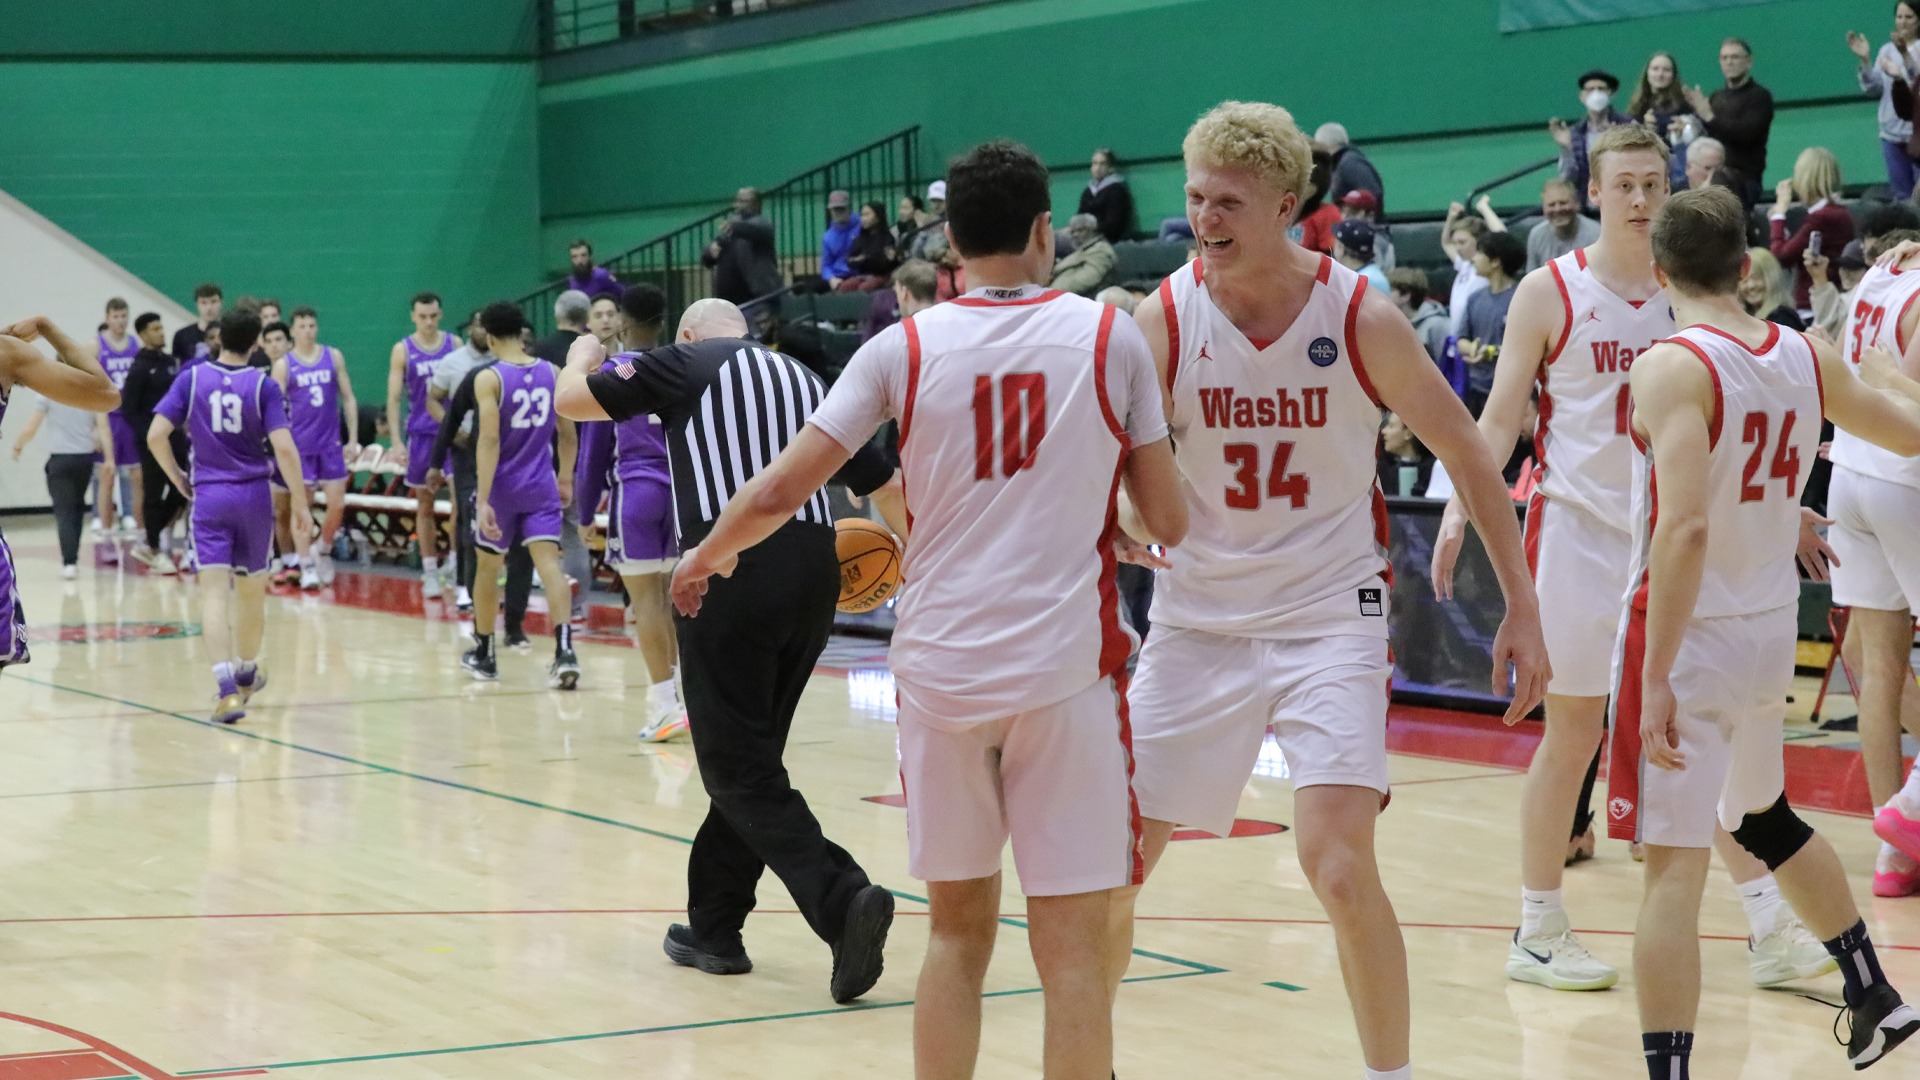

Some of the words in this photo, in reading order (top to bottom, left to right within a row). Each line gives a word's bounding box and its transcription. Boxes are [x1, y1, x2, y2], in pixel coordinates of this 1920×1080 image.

[984, 288, 1007, 298] NIKE
[296, 370, 331, 387] NYU
[309, 385, 323, 407] 3
[209, 390, 242, 434] 13
[511, 386, 550, 428] 23
[970, 371, 1047, 481] 10
[1198, 386, 1328, 429] WashU
[1223, 440, 1310, 511] 34
[1739, 408, 1800, 504] 24
[1364, 591, 1376, 600] XL
